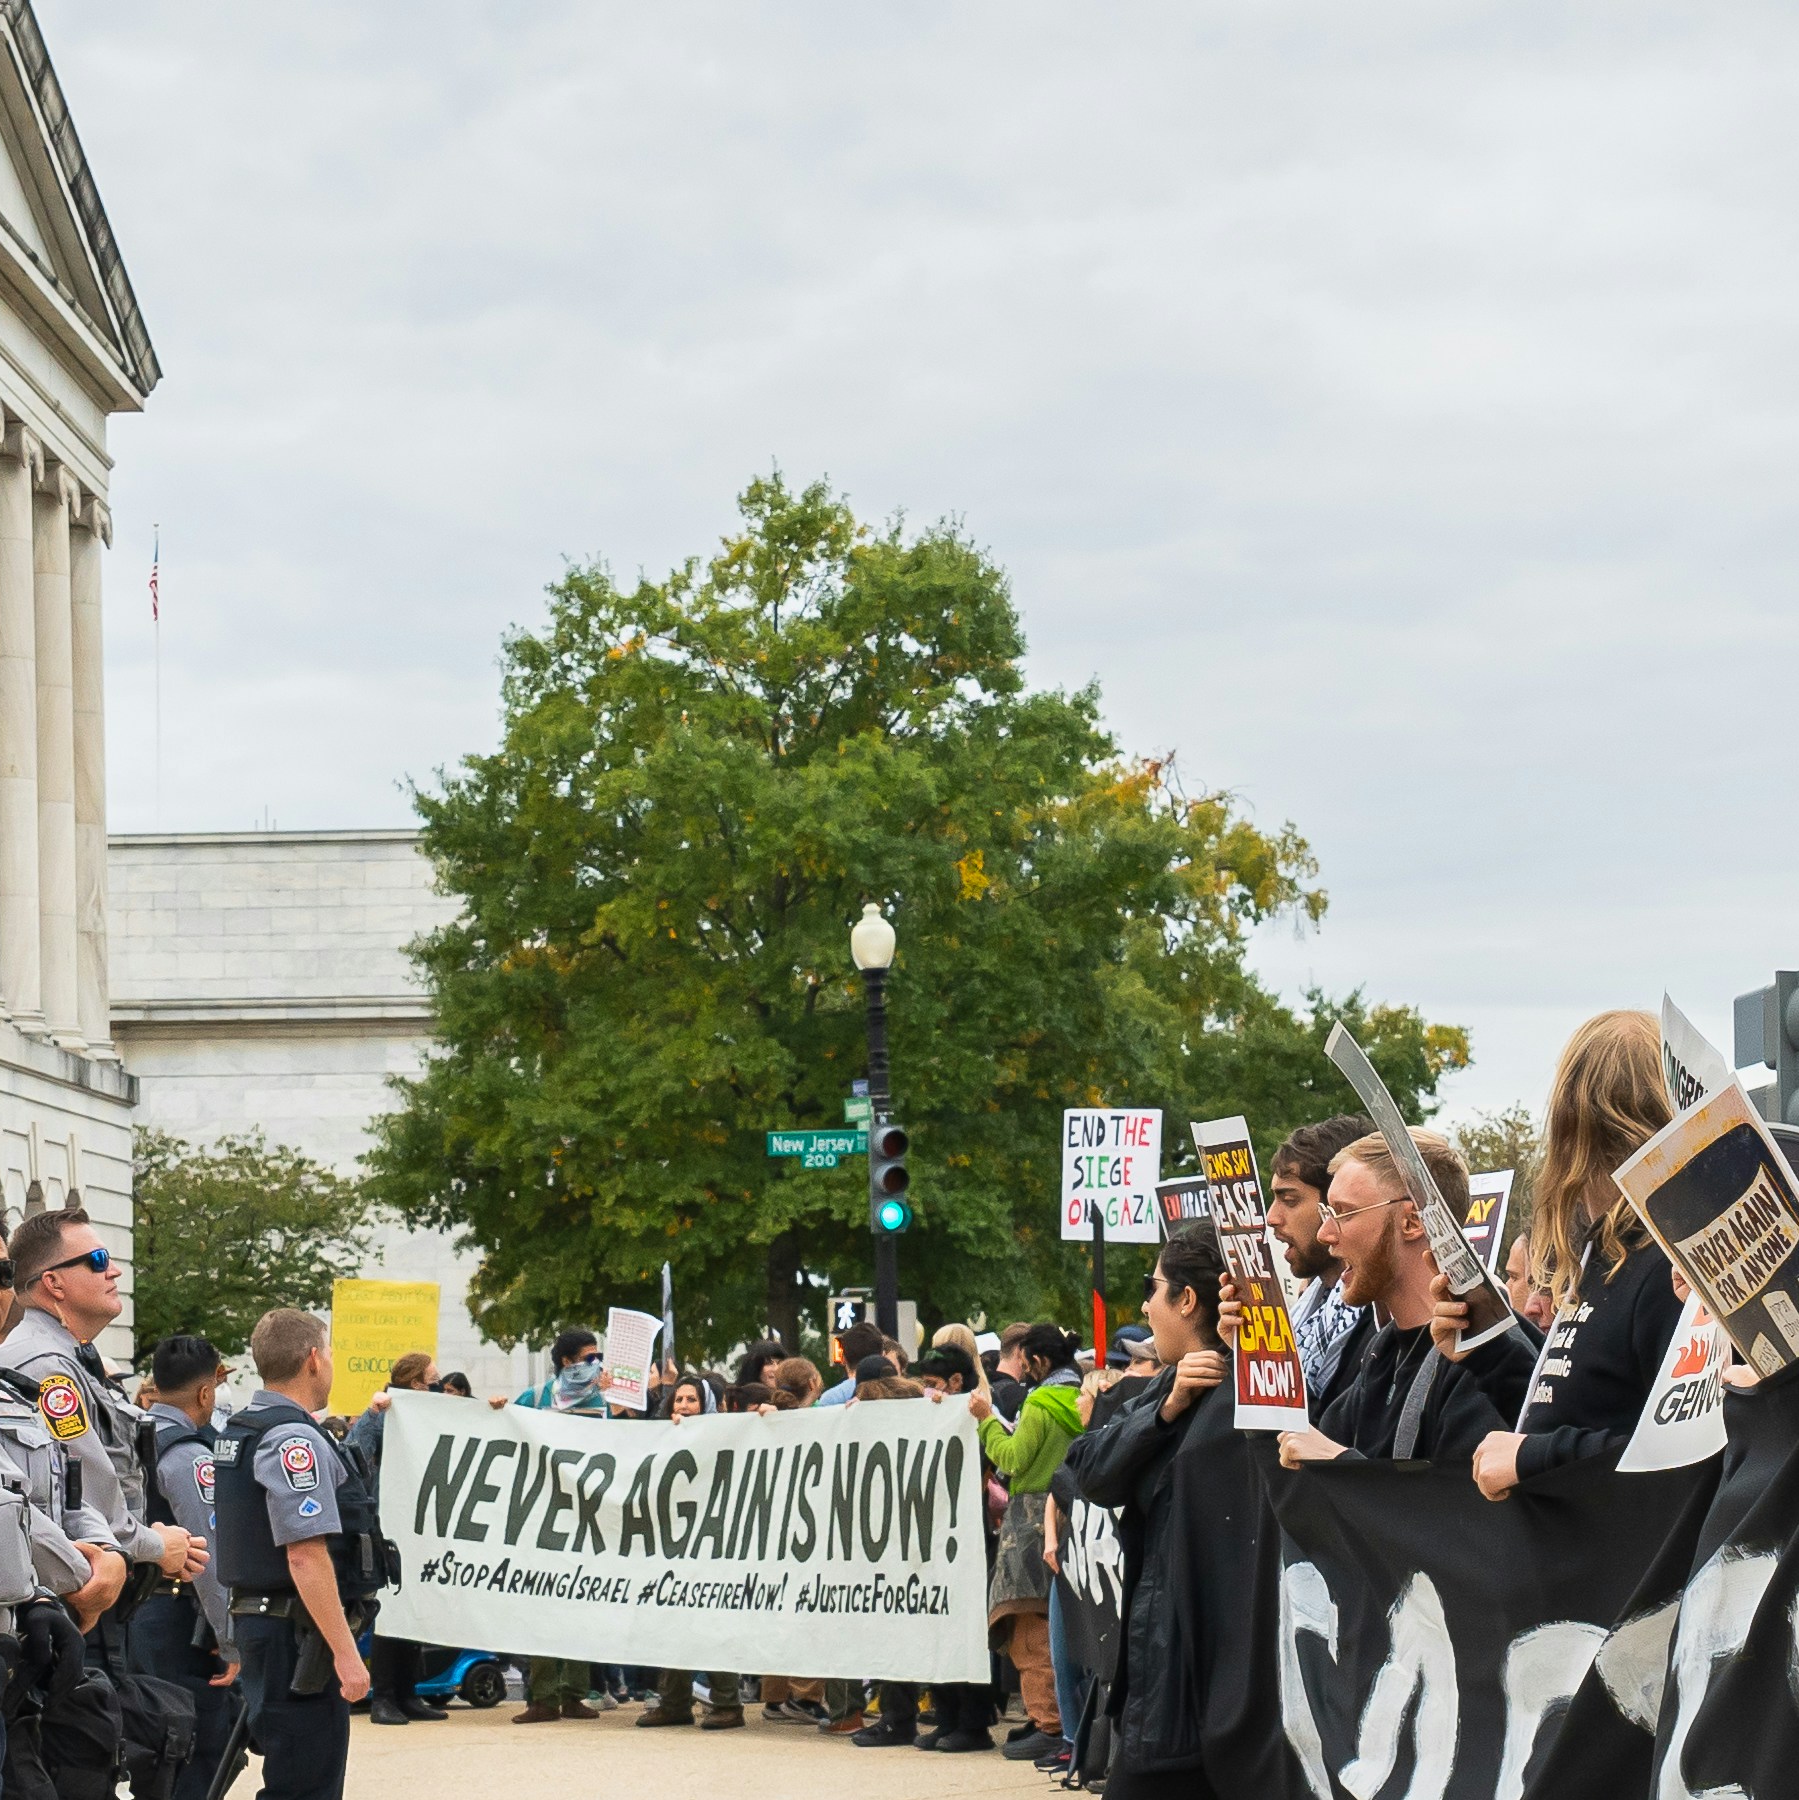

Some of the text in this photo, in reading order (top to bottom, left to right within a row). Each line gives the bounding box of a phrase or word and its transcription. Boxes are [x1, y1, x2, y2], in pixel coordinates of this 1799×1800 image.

[772, 1135, 805, 1153] New
[808, 1135, 855, 1154] Jersey
[1067, 1115, 1153, 1148] END THE
[804, 1153, 836, 1168] 200
[1071, 1155, 1133, 1191] SIEGE
[1206, 1150, 1233, 1182] EWS
[1105, 1194, 1155, 1227] GAZA
[1465, 1197, 1496, 1226] AY
[1687, 1182, 1783, 1285] NEVER AGAIN
[1224, 1232, 1272, 1280] FIRE
[1715, 1225, 1793, 1310] FOR ANYONE
[1251, 1281, 1264, 1302] IN
[1237, 1305, 1298, 1355] GAZA
[347, 1355, 393, 1373] GENOCI
[1249, 1359, 1297, 1399] NOW!
[213, 1439, 240, 1456] LICE
[413, 1433, 617, 1557] NEVER
[617, 1446, 785, 1562] AGAIN
[776, 1440, 824, 1564] IS
[826, 1435, 965, 1565] NOW!
[419, 1550, 950, 1616] #STOPARMINGISRAEL #CEASEFIRENOW! #JUSTICEFORGAZA
